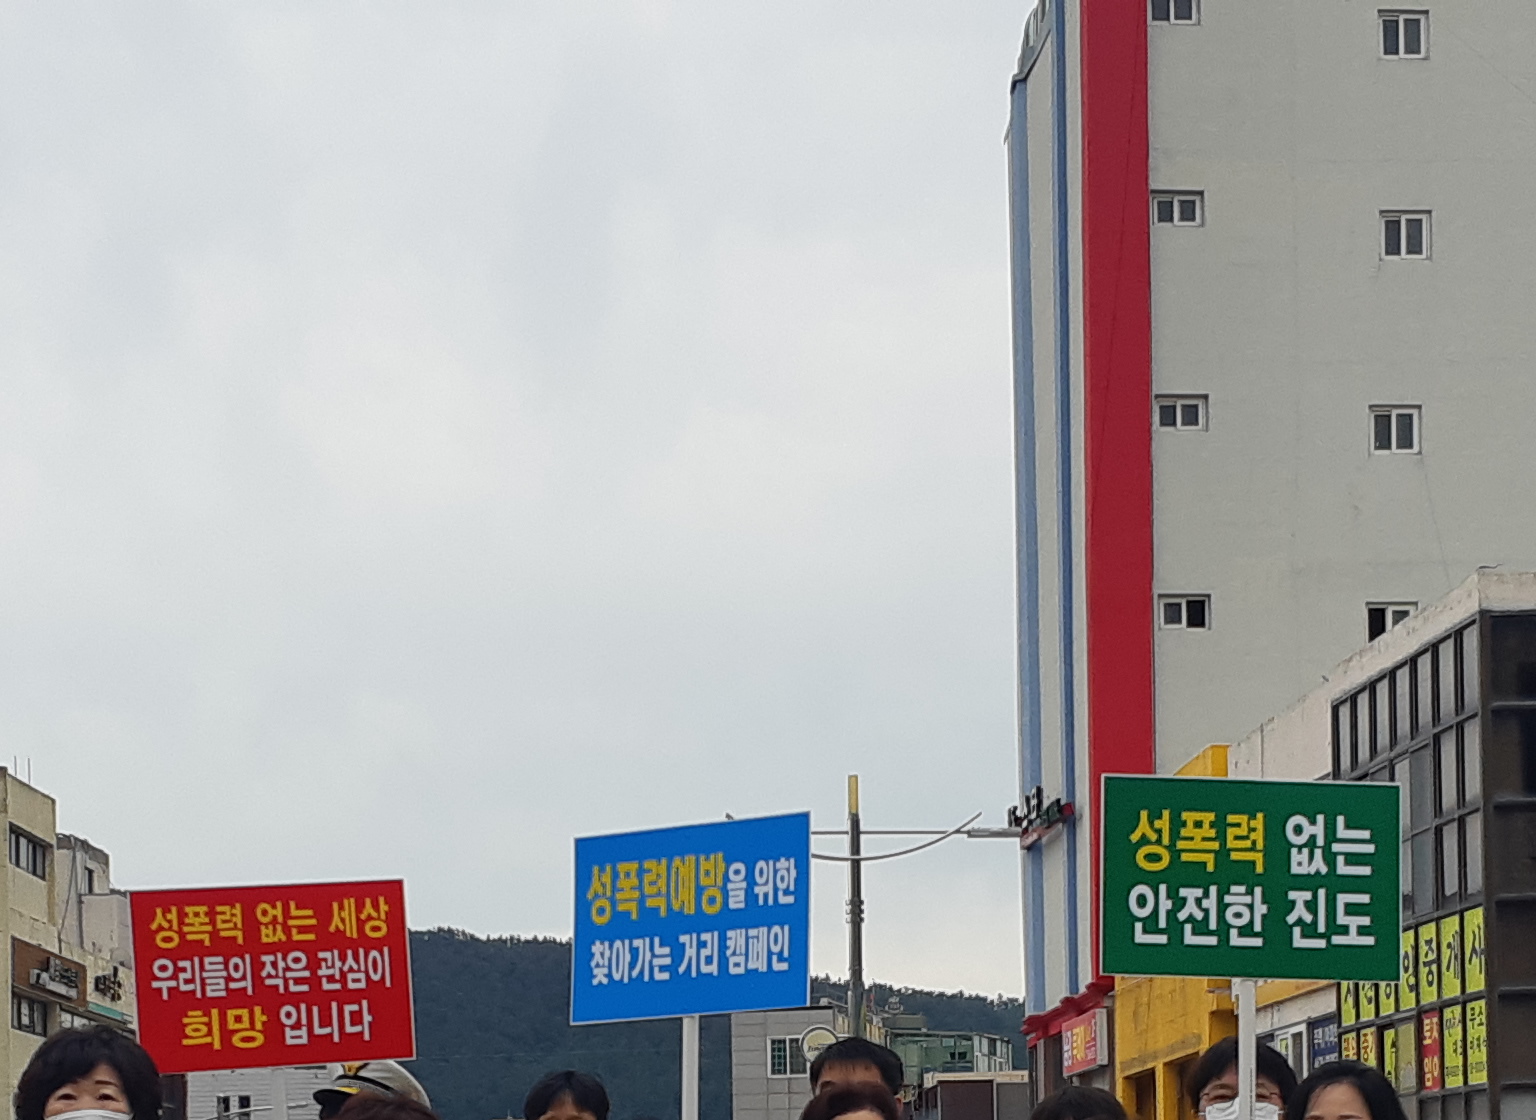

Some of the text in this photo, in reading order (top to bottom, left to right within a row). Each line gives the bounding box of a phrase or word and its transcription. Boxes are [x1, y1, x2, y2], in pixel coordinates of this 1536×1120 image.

[1129, 809, 1376, 877] 성폭력 없는
[588, 854, 797, 924] 성폭력예방을 위한
[1128, 884, 1375, 949] 안전한 진도
[151, 896, 389, 949] 성폭력 없는 세상
[151, 945, 392, 1000] 우리들의 작은 관심이
[591, 924, 789, 986] 찾아가는 거리 캠페인
[182, 1000, 373, 1050] 희망 입니다
